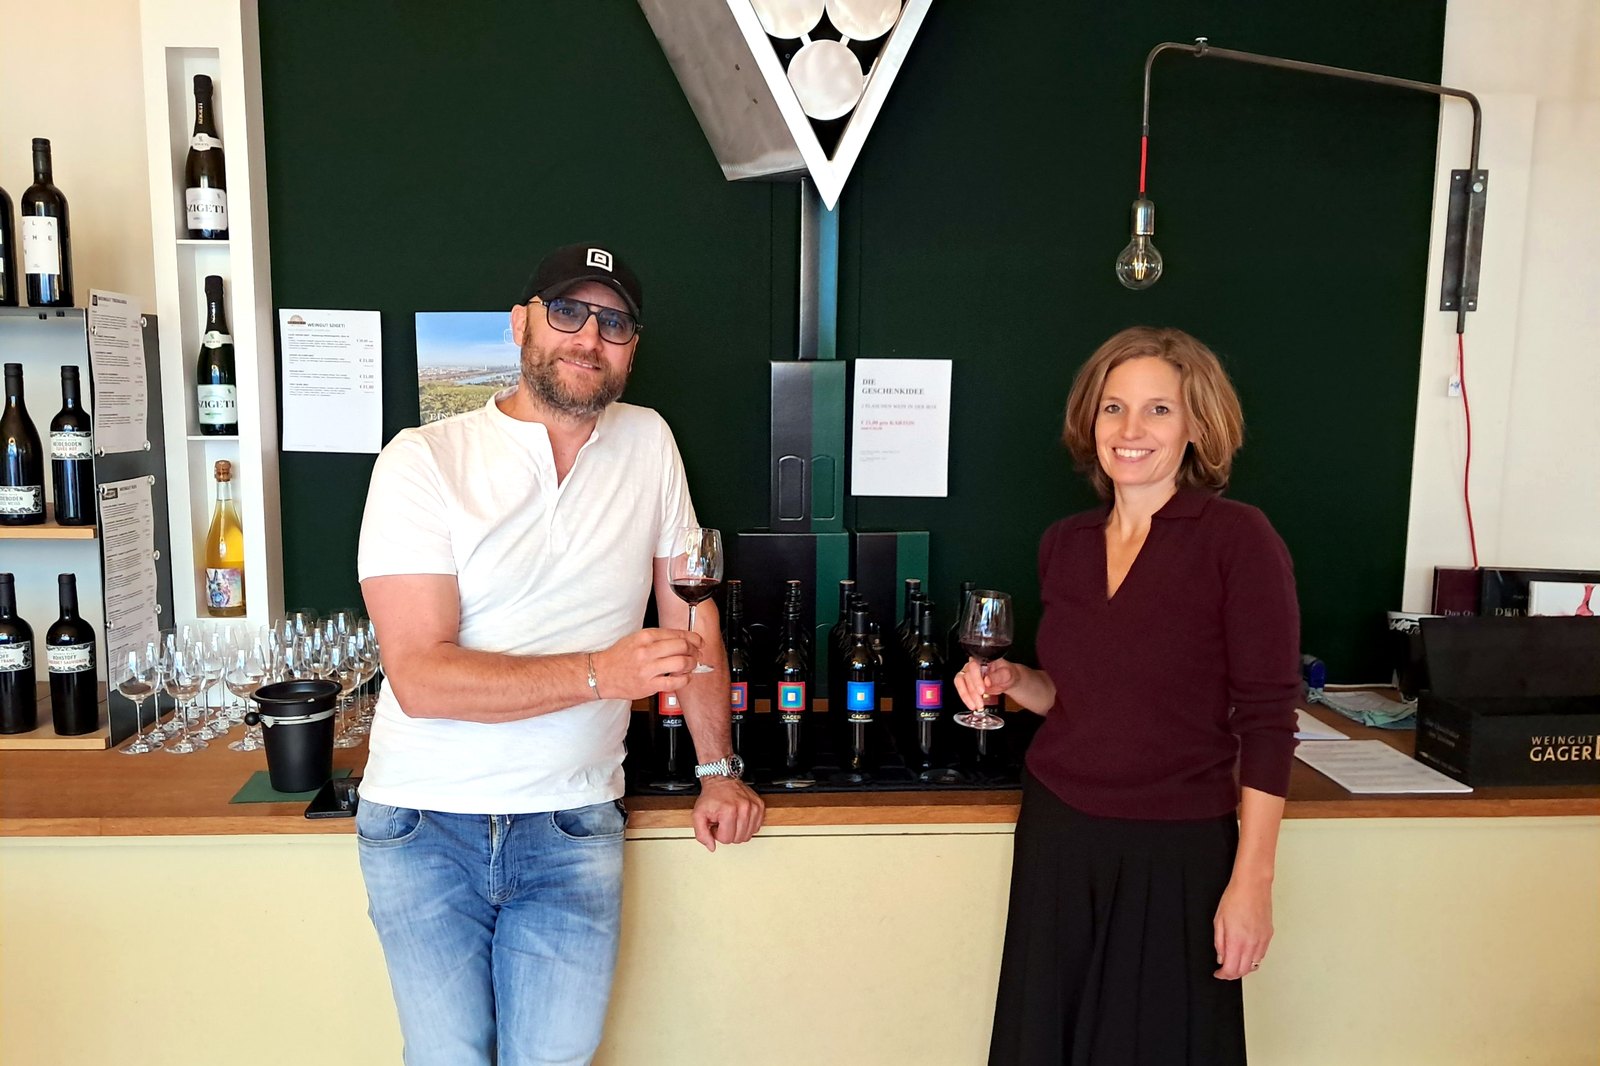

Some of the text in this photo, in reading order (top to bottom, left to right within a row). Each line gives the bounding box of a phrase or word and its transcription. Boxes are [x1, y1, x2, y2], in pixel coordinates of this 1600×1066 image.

[862, 378, 877, 386] DIE
[861, 387, 925, 396] GESCHENKIDEE
[1531, 735, 1593, 745] WEINGUT
[1529, 745, 1593, 762] GAGER
